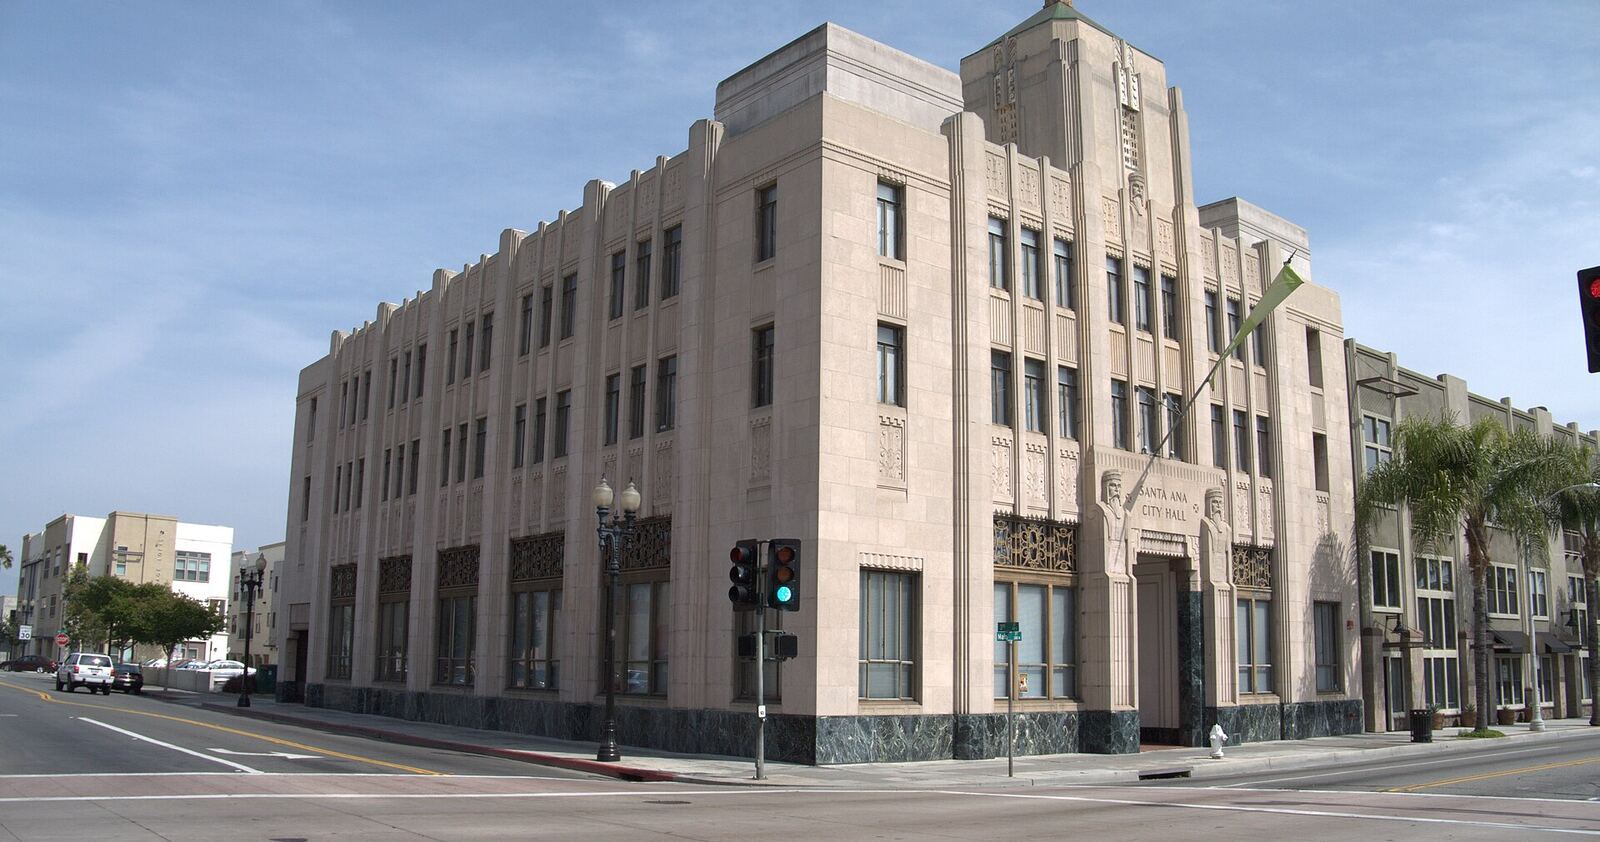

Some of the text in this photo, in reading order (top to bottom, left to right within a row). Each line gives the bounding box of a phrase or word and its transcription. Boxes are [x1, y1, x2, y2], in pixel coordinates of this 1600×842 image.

[1139, 485, 1188, 504] SANTA ANA
[1142, 504, 1187, 522] CITY HALL
